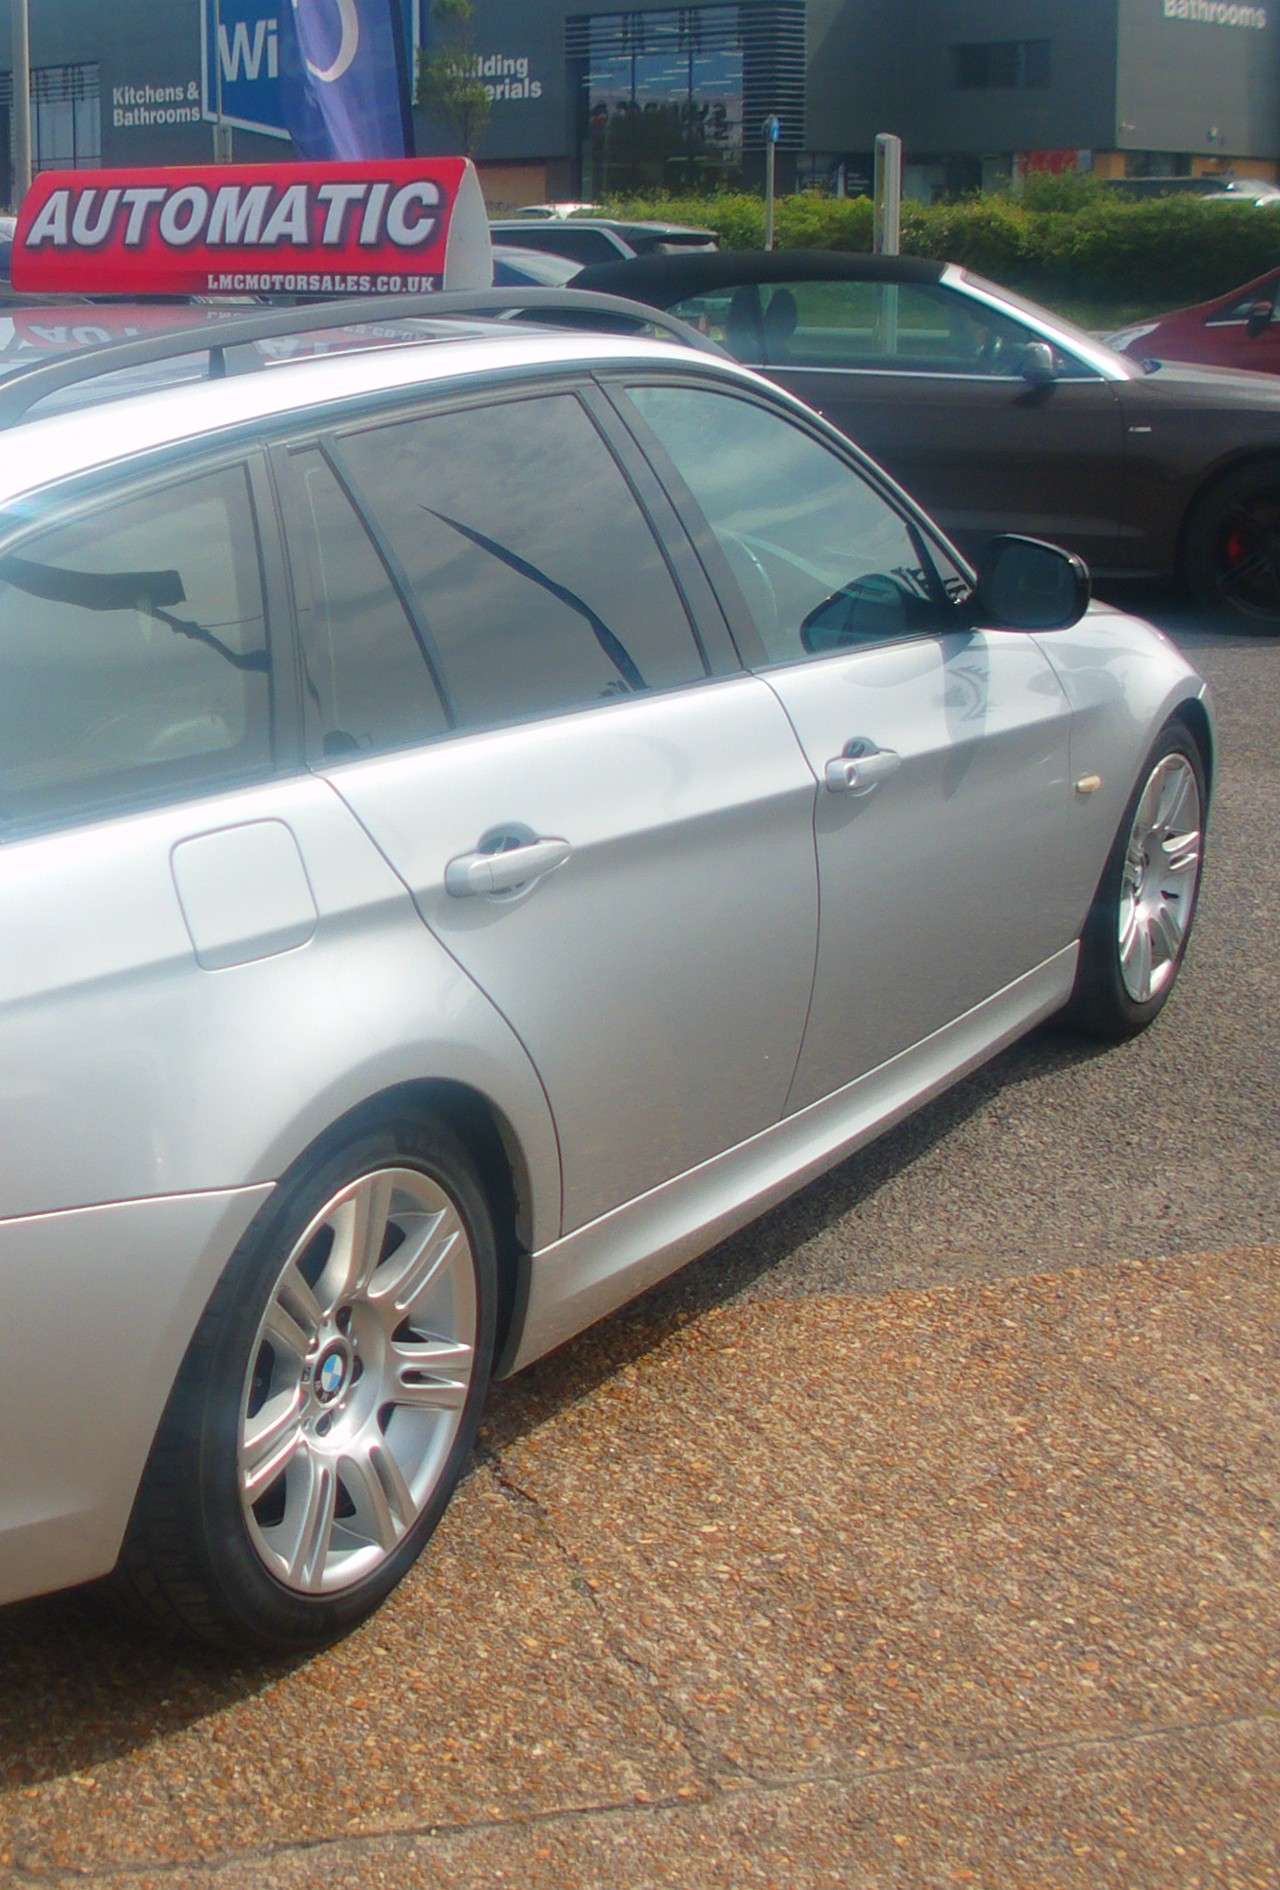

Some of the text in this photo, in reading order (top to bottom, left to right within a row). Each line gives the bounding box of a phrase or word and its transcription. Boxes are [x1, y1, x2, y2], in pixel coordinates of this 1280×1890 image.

[112, 81, 200, 105] Kitchens &
[113, 106, 200, 127] Bathrooms
[24, 180, 441, 248] AUTOMATIC
[207, 273, 435, 293] LMCMOTORSALES.CO.UK
